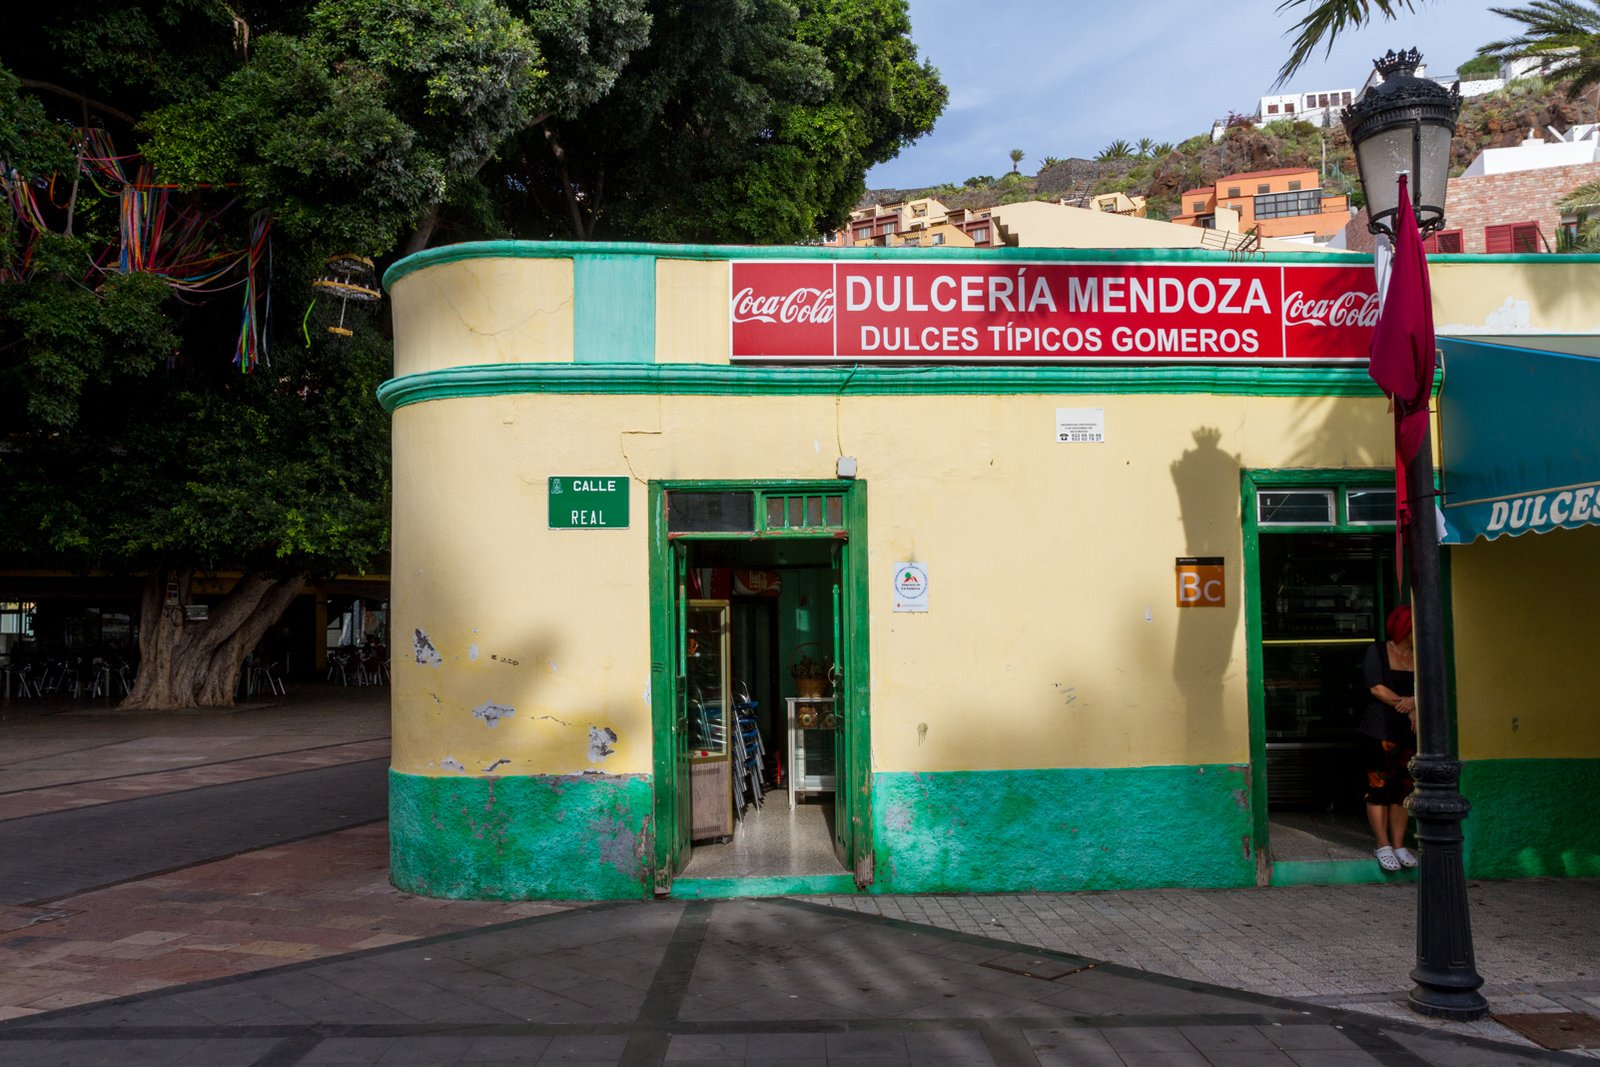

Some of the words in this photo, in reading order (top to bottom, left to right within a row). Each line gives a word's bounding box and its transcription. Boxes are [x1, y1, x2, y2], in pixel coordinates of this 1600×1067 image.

[732, 287, 834, 324] Coca-Cola
[845, 267, 1057, 312] DULCERÍA
[1069, 275, 1272, 314] MENDOZA
[1284, 290, 1380, 327] Coca-Cola
[860, 324, 979, 351] DULCES
[987, 321, 1102, 352] TÍPICOS
[1111, 327, 1259, 353] GOMEROS
[573, 480, 616, 492] CALLE
[571, 510, 606, 525] REAL
[1179, 571, 1222, 602] Bc
